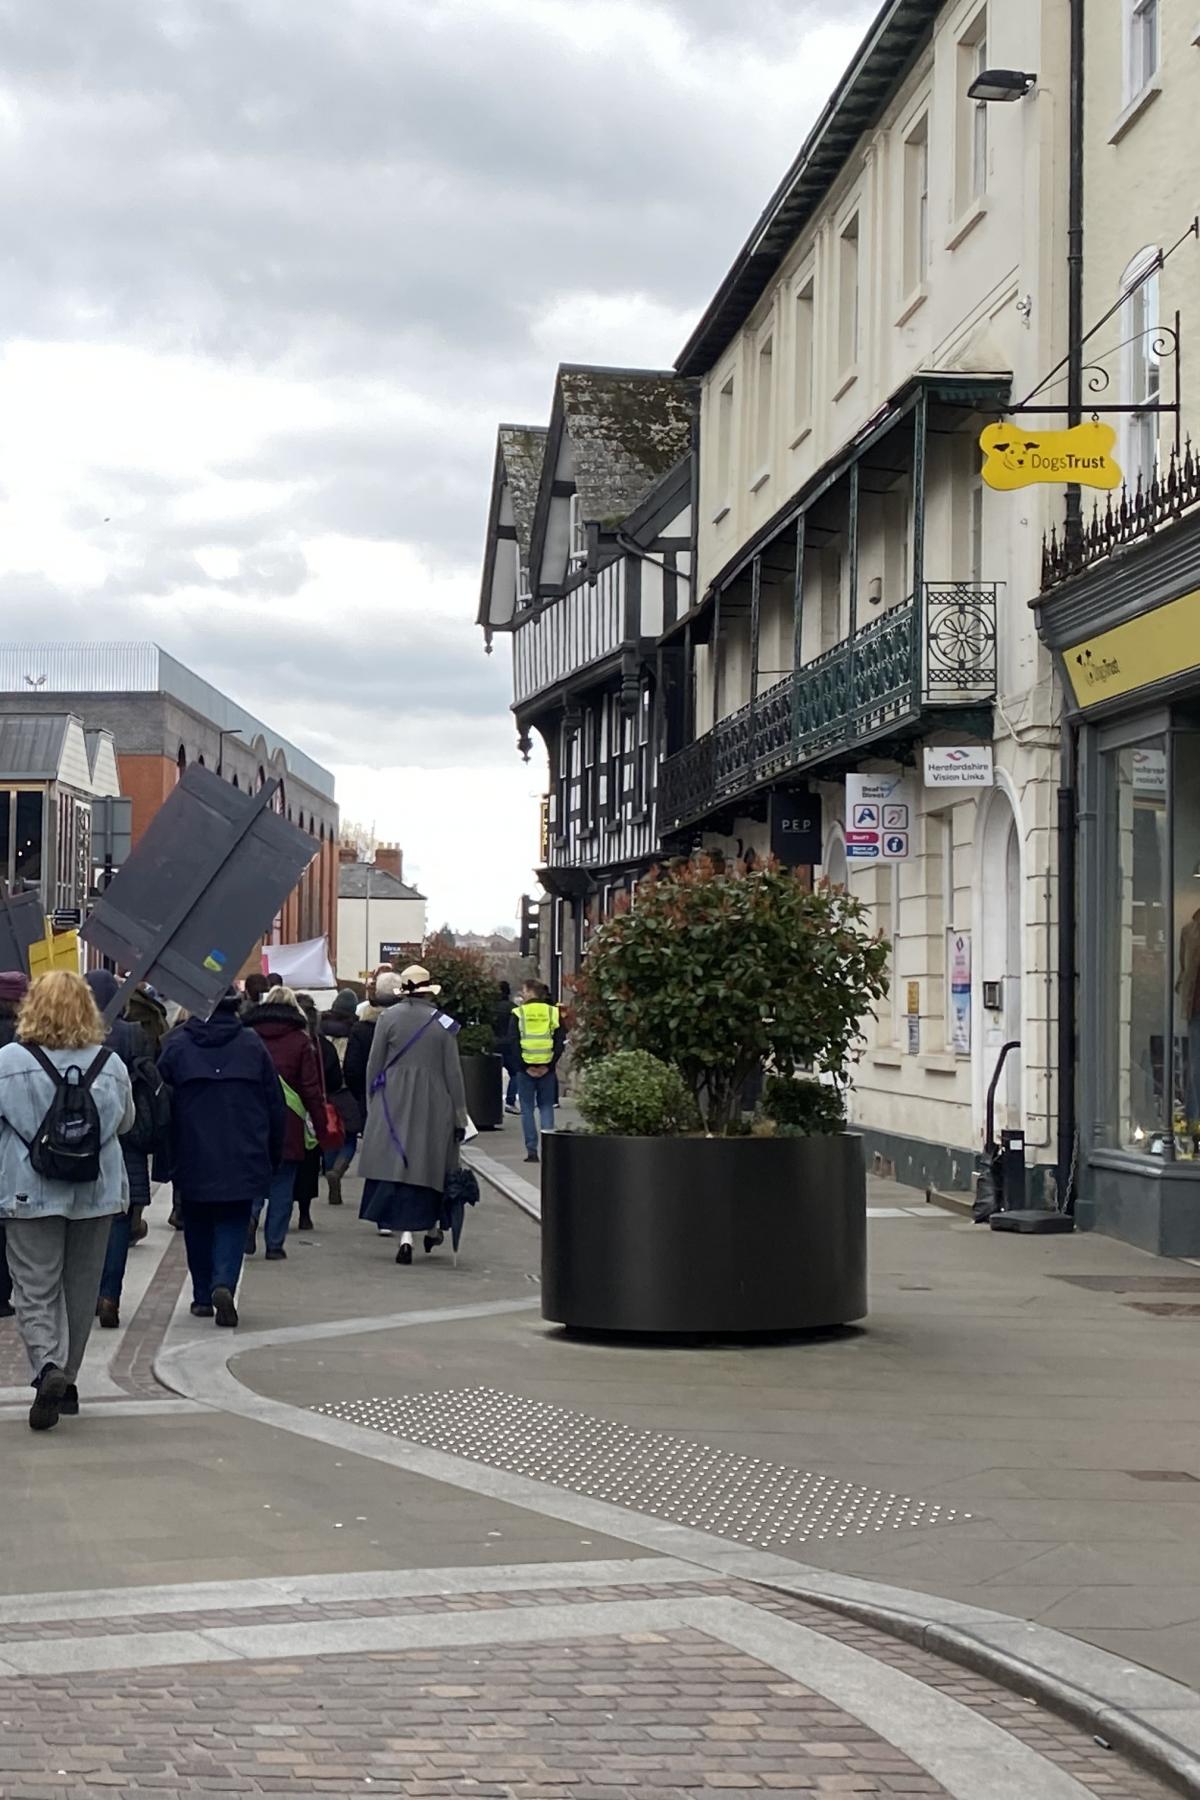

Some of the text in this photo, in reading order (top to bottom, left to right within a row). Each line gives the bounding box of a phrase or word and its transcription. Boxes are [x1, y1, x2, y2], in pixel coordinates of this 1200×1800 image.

[928, 763, 989, 771] Herefordshire
[933, 773, 985, 781] Vision Links
[782, 819, 811, 830] PEP
